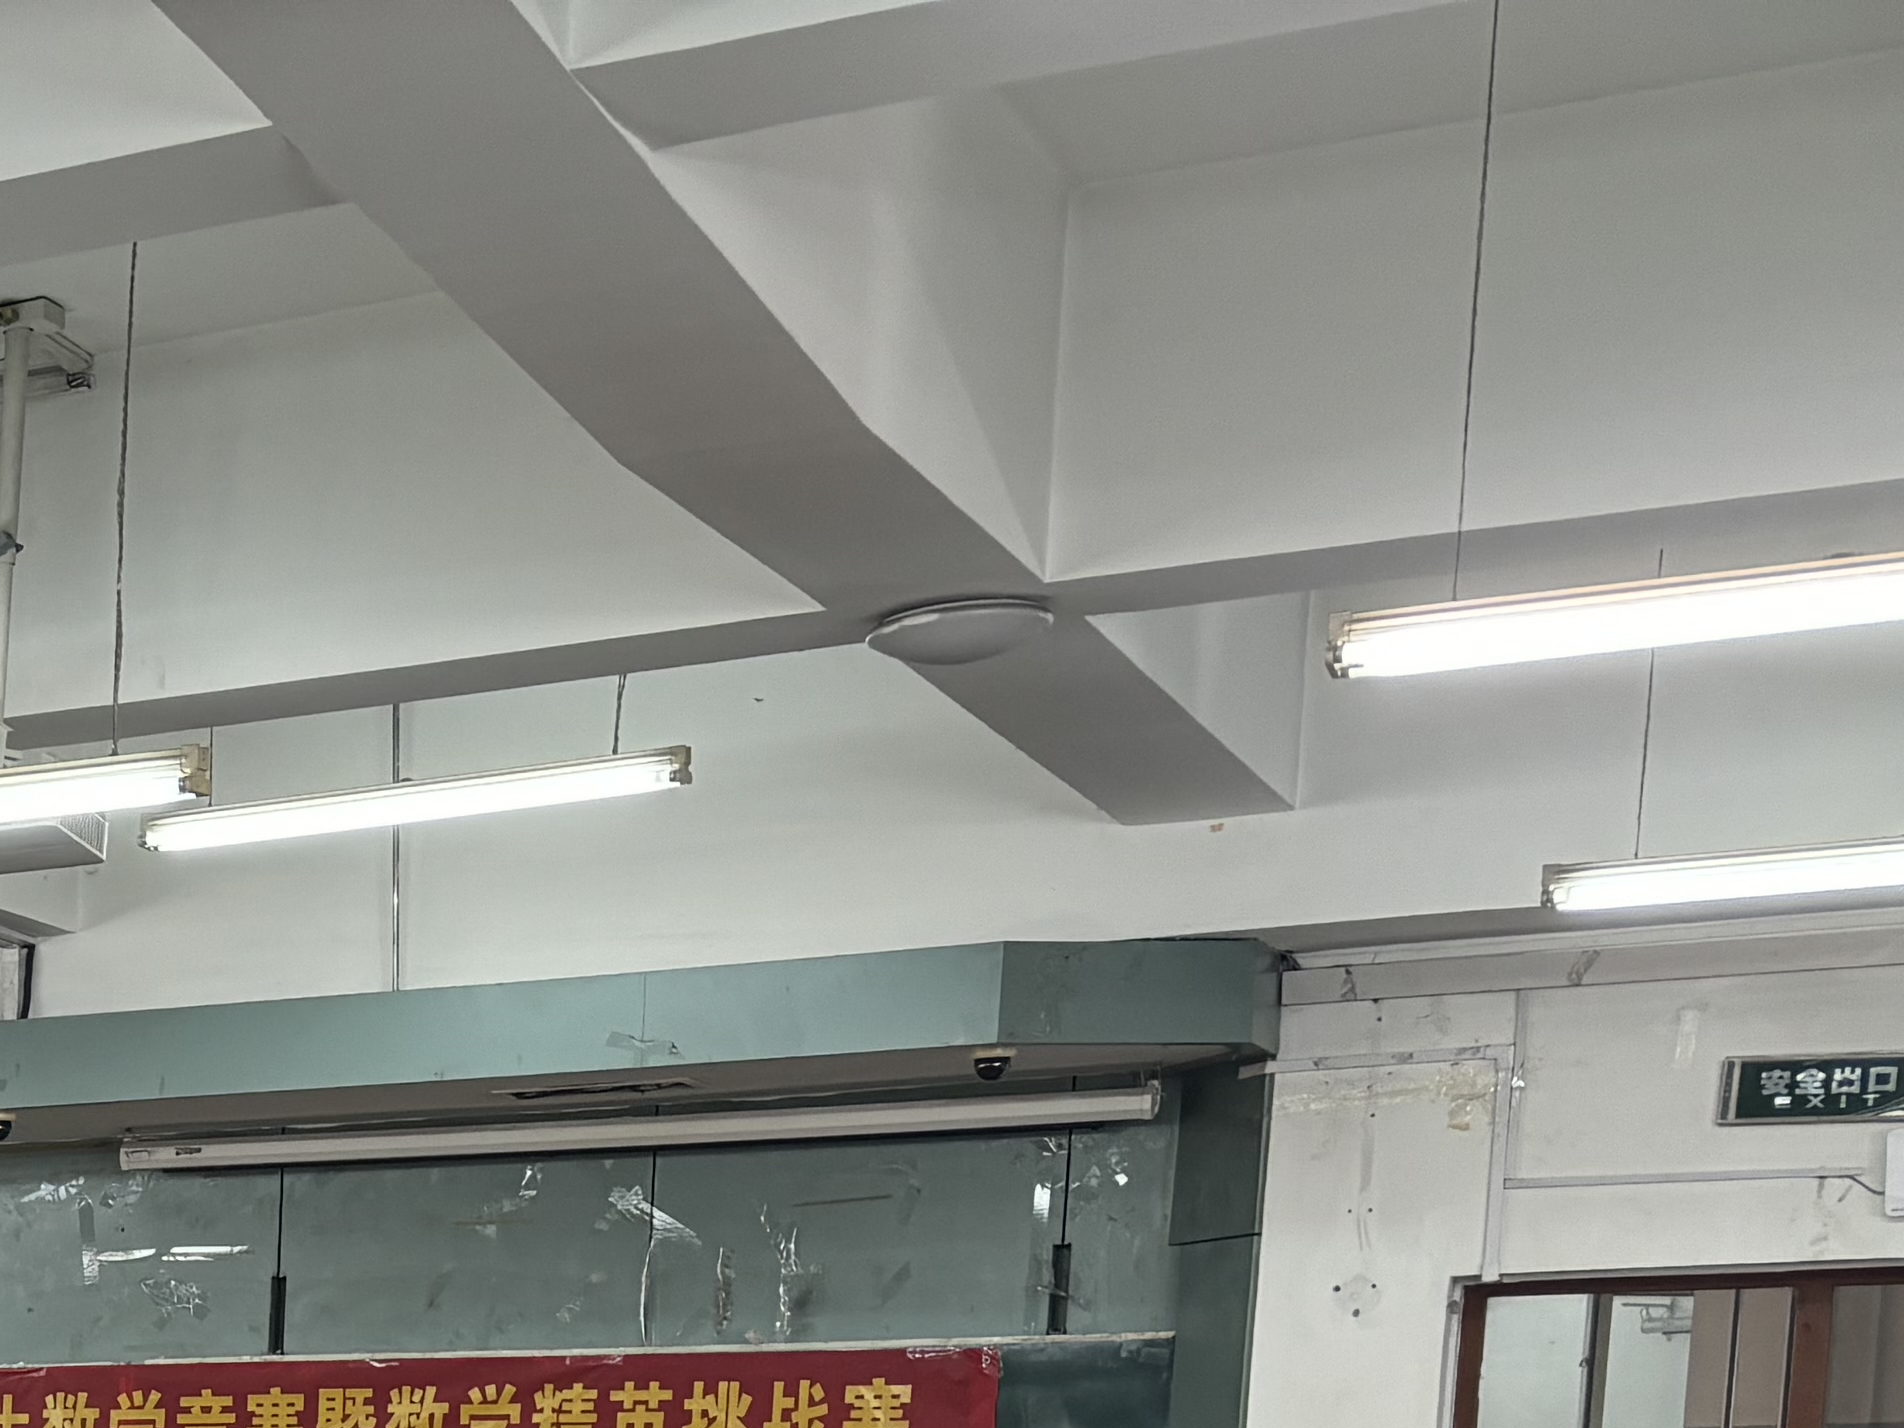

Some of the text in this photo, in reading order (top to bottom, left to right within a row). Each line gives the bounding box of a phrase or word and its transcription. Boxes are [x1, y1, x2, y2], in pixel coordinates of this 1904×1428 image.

[1760, 1066, 1899, 1095] 安全出口
[1773, 1093, 1881, 1109] EXIT
